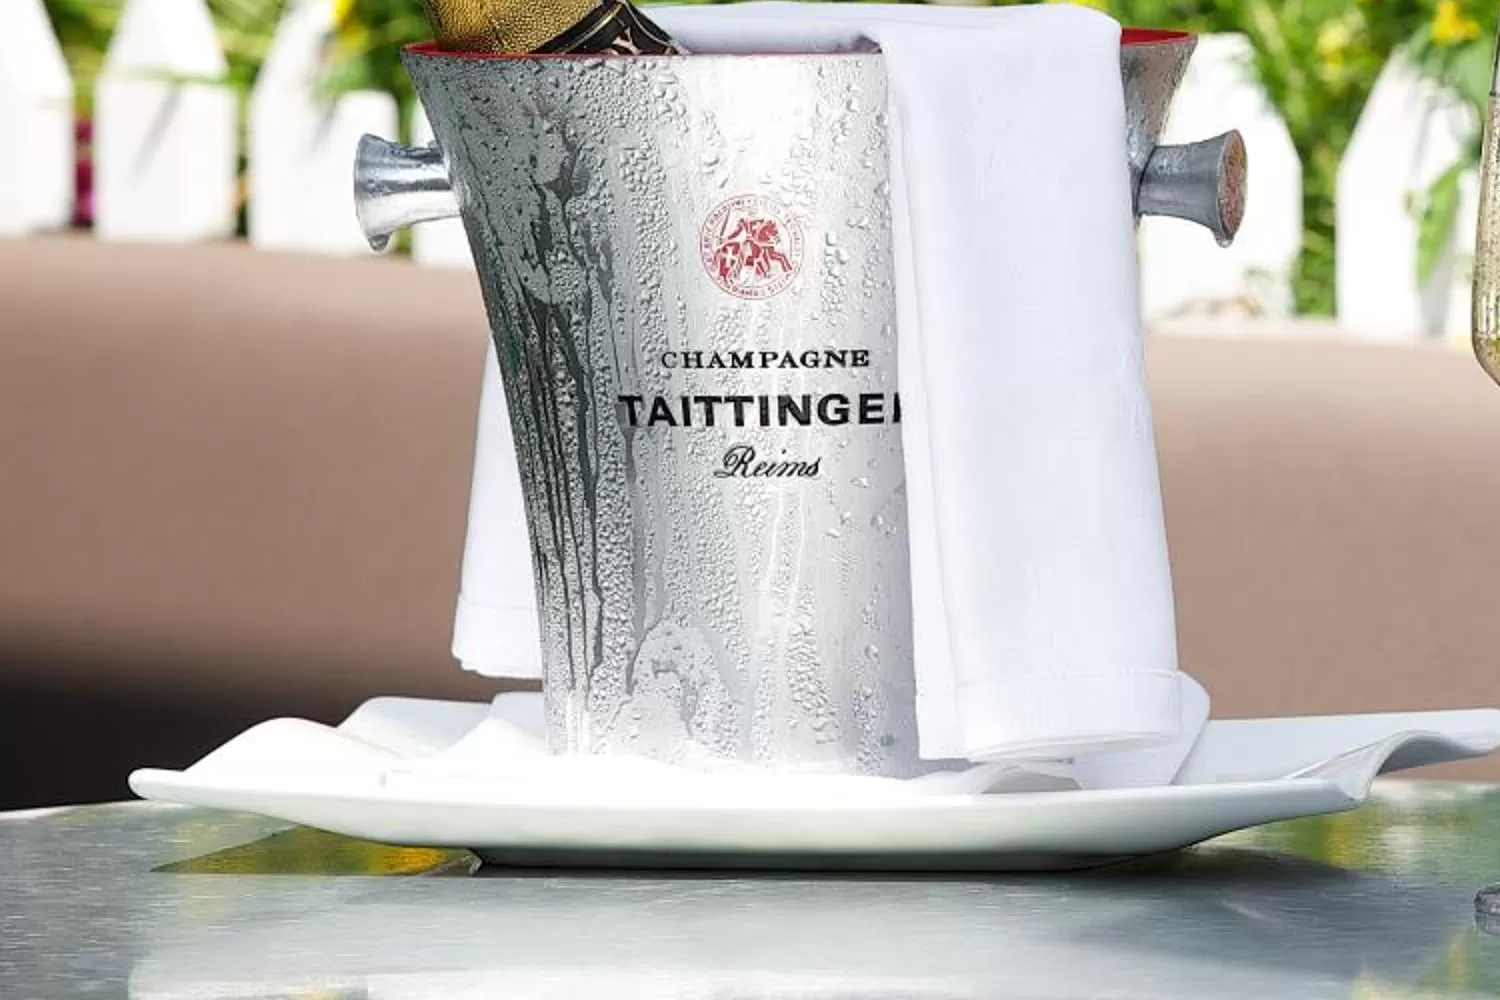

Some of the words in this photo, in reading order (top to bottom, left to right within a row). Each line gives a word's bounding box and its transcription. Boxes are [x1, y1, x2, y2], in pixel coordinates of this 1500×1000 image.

[661, 349, 870, 369] CHAMPAGNE
[618, 392, 901, 427] TAITTINGE
[714, 445, 821, 479] Reims
